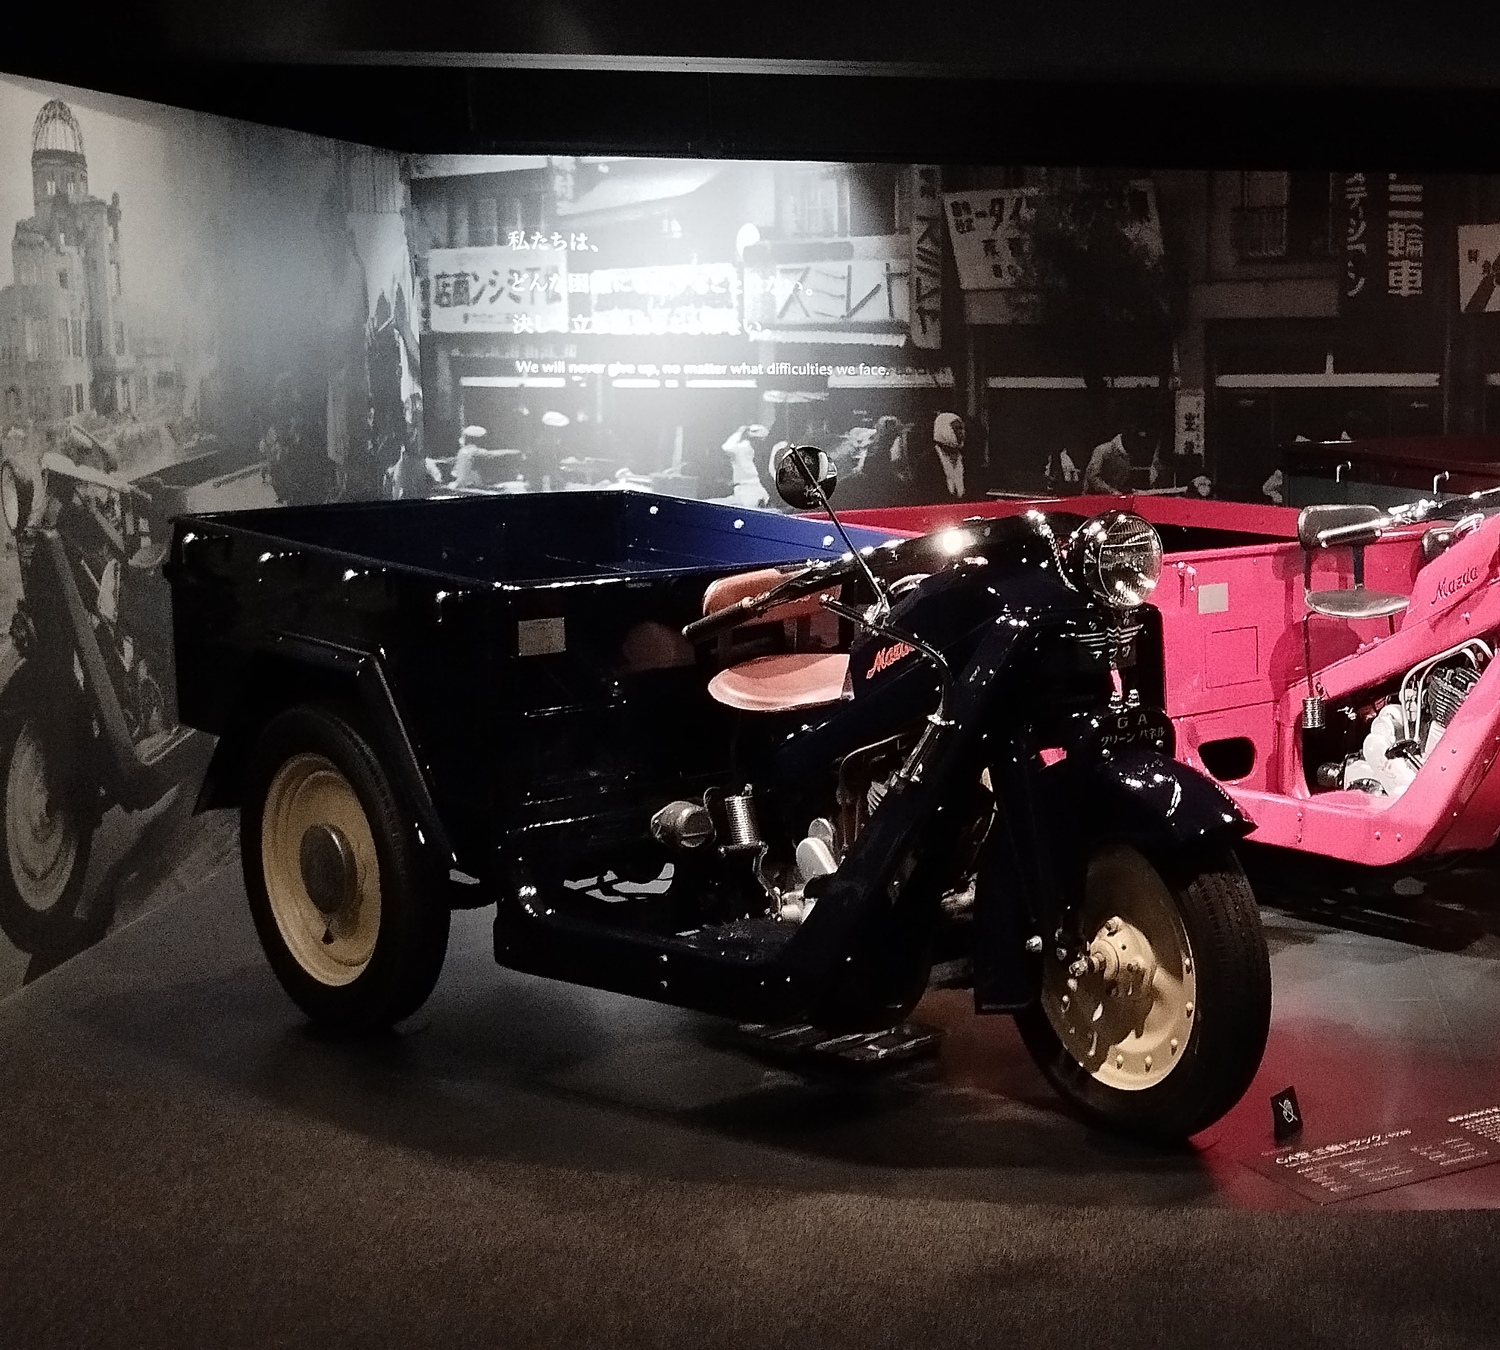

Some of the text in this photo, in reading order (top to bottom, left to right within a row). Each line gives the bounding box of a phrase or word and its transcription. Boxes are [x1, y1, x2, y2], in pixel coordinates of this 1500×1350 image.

[509, 231, 598, 252] 私たちは、
[1387, 173, 1423, 297] 三輪車
[515, 360, 890, 378] We will never give up, no matter what difficulties we face.
[1430, 566, 1479, 605] Mazda
